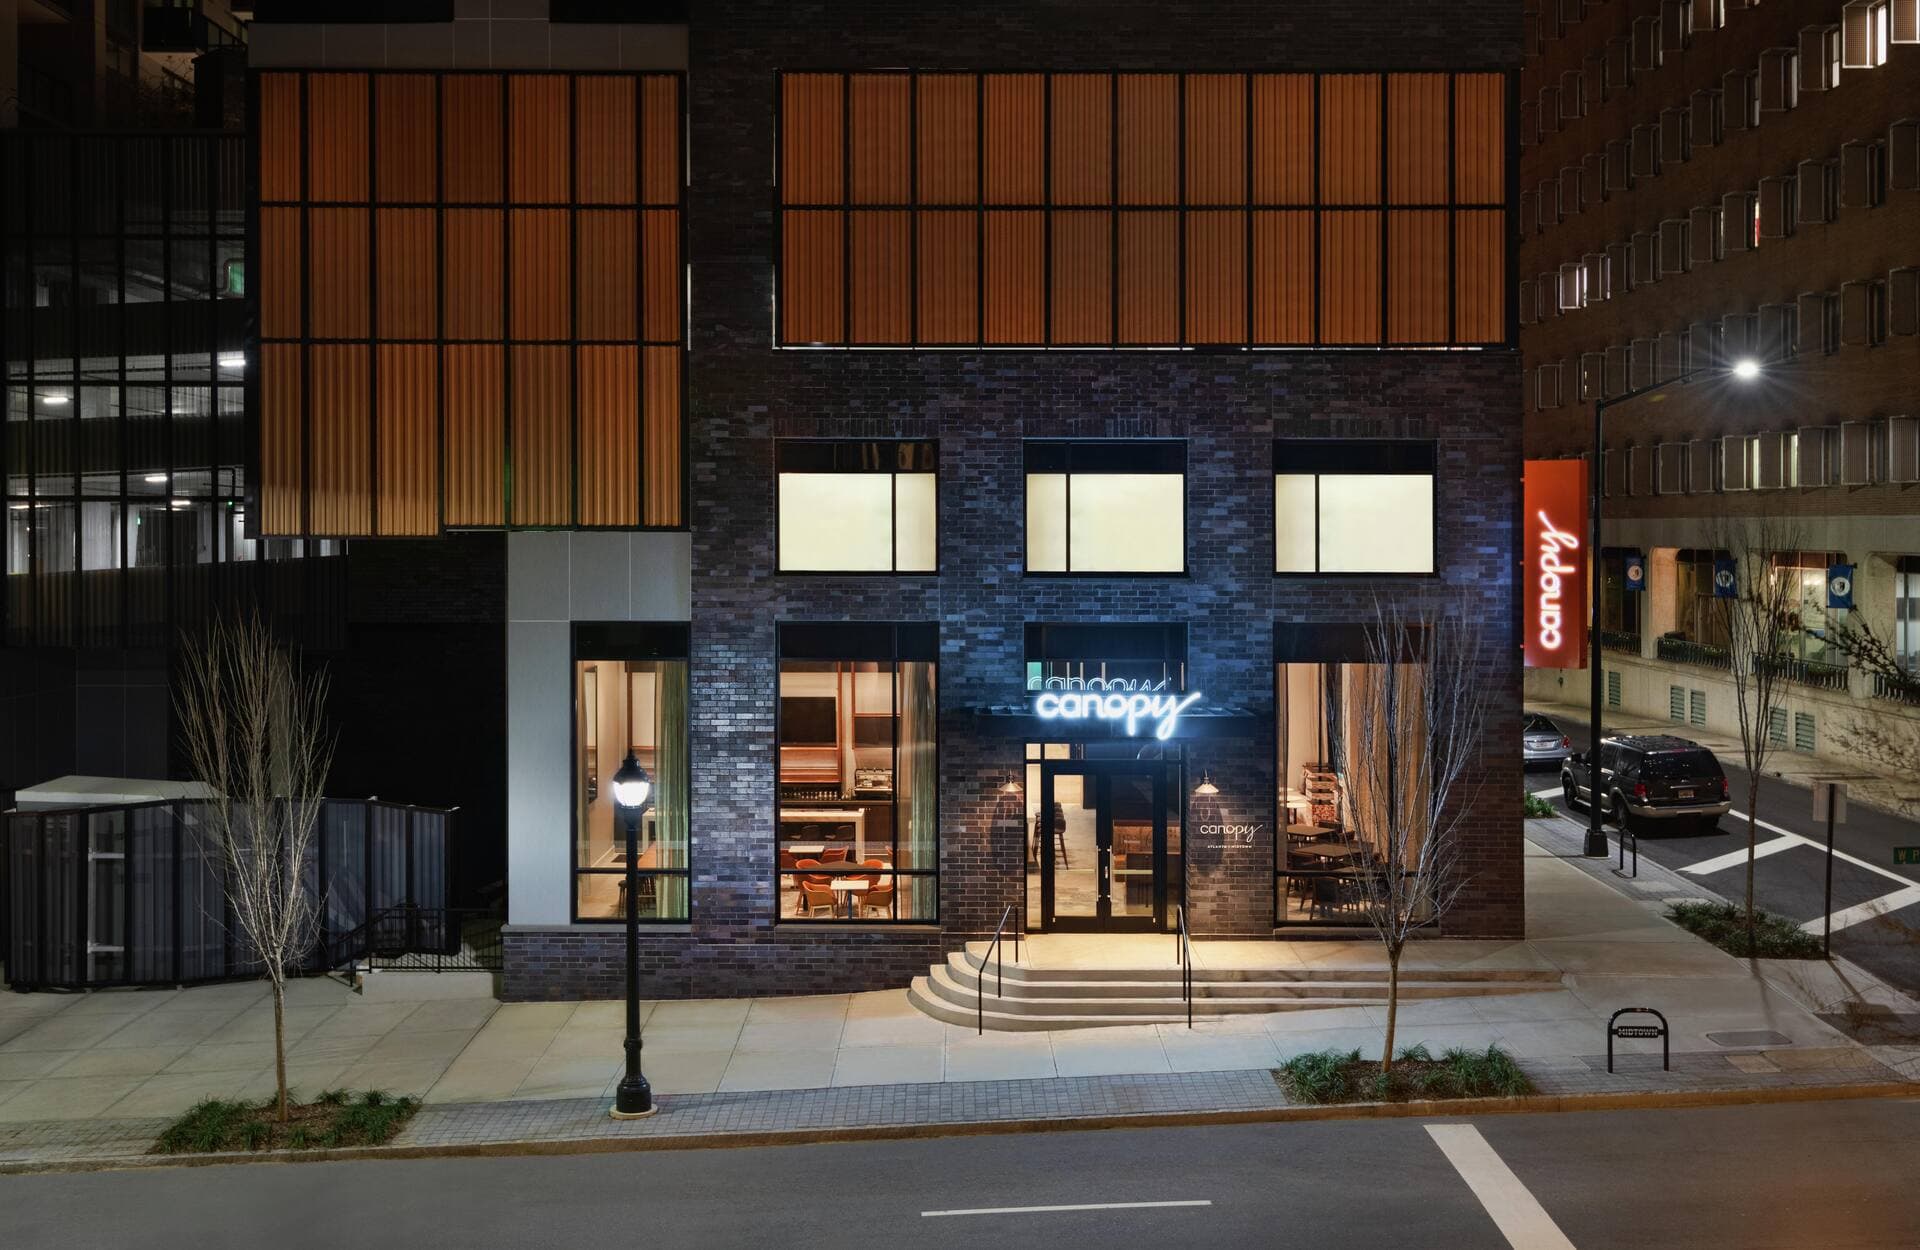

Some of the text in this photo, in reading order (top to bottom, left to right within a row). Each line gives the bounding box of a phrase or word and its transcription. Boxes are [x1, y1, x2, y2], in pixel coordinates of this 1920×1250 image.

[1538, 510, 1579, 650] canopy
[1036, 692, 1201, 740] canopy
[1200, 824, 1263, 842] canopy
[1618, 1028, 1658, 1036] MIDTOWN
